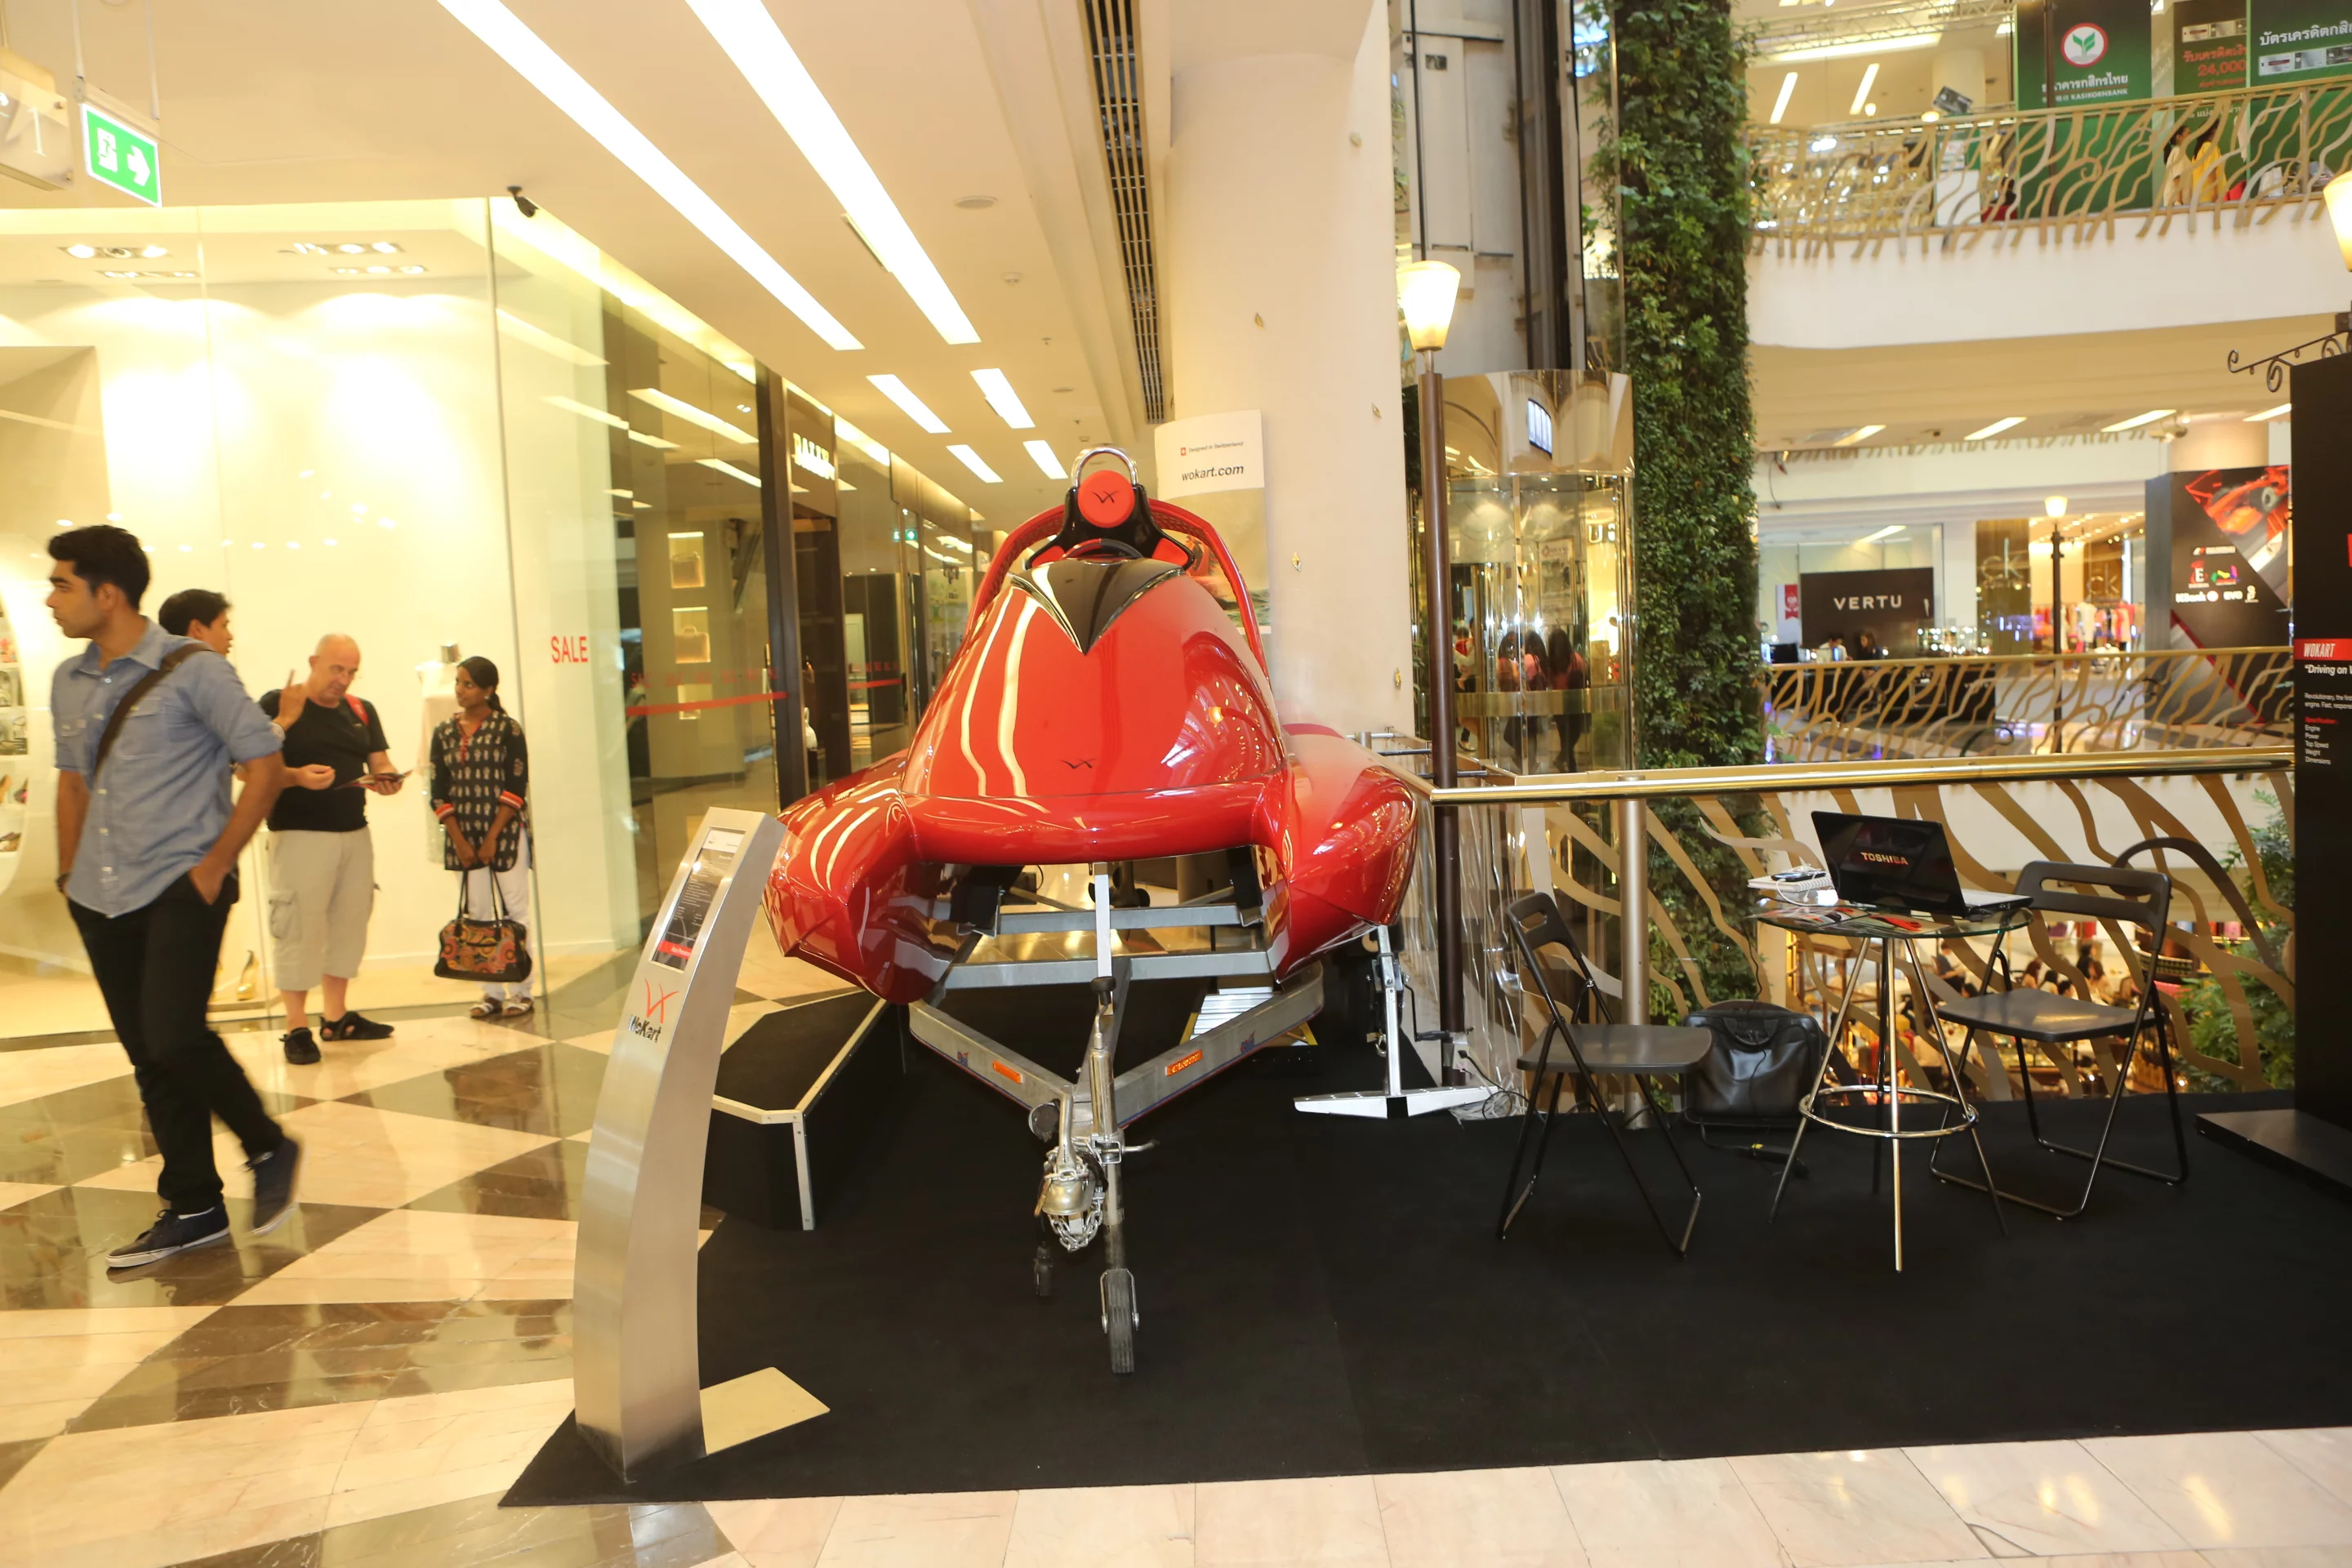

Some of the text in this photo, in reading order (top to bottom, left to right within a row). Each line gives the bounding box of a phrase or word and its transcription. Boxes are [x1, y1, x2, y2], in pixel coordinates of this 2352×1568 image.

[1188, 445, 1208, 453] Designed
[1214, 441, 1244, 449] Switzerland
[1182, 466, 1245, 482] wokart.com
[1833, 595, 1902, 611] VERTU
[550, 635, 589, 664] SALE
[2304, 643, 2336, 658] WOKART
[2336, 666, 2348, 675] on
[2305, 724, 2321, 733] Engine
[1860, 852, 1909, 866] TOSHIBA
